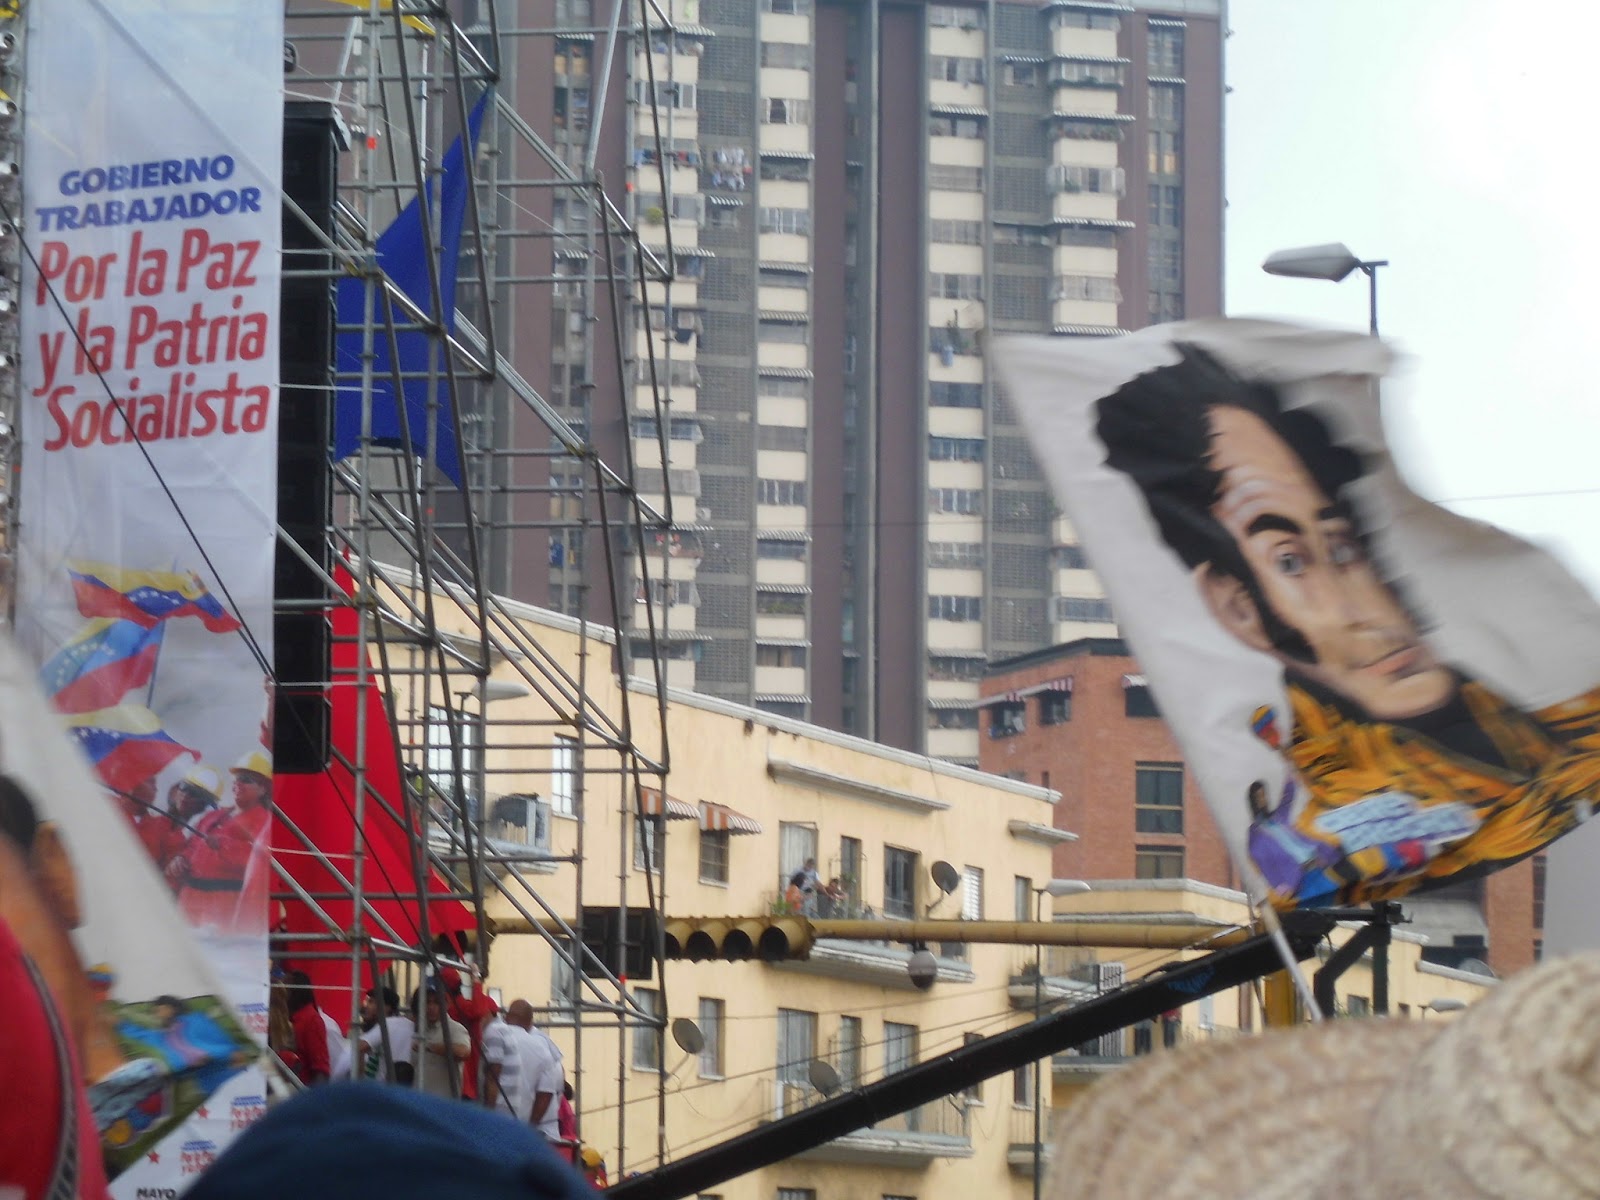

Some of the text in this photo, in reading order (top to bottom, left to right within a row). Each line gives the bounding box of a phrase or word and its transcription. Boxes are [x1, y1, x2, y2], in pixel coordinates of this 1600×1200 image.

[35, 187, 262, 232] TRABAJADOR
[59, 155, 235, 197] GOBIERNO
[36, 228, 261, 306] Por la Paz
[32, 295, 268, 397] y la Patria
[44, 371, 270, 451] Socialista
